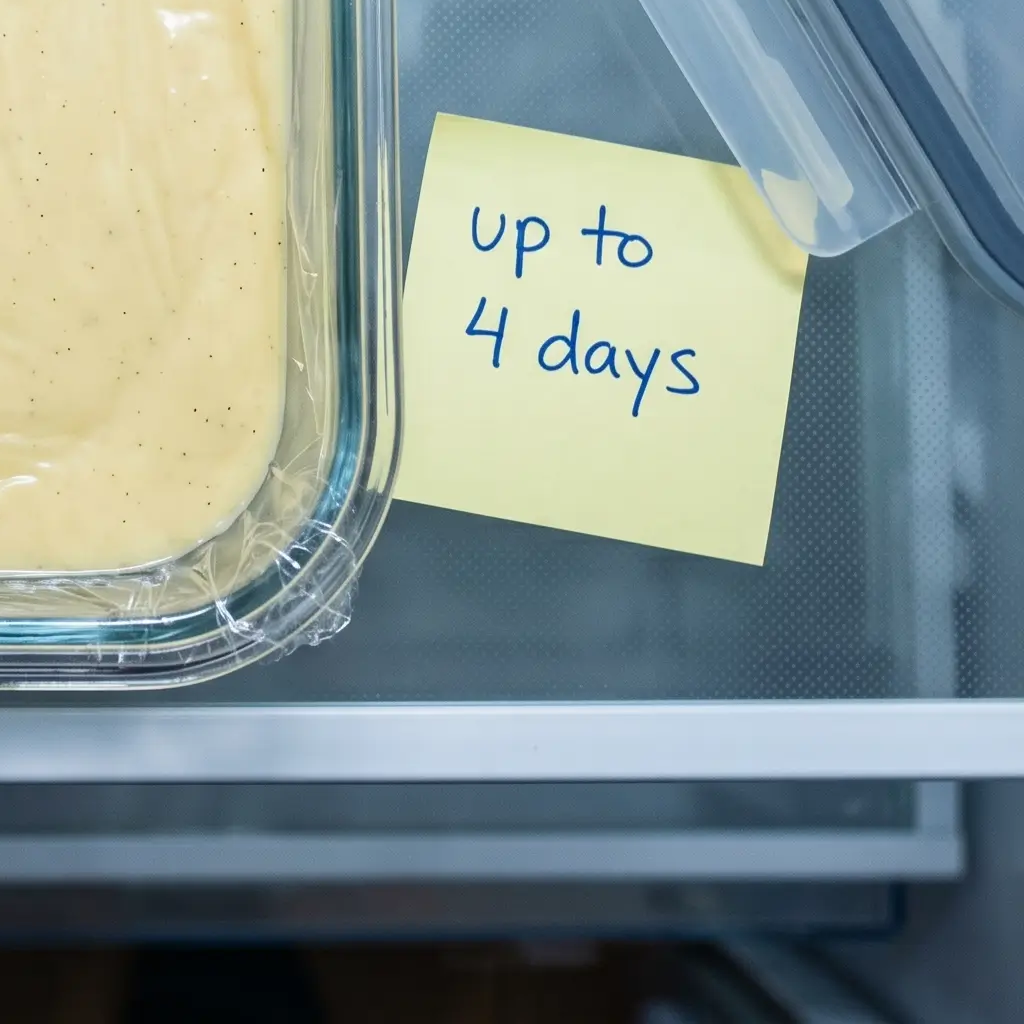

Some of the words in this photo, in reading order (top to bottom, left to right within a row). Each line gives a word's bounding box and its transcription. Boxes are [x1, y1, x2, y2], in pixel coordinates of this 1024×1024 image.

[472, 208, 550, 277] up
[581, 206, 653, 268] to
[466, 297, 508, 368] 4
[538, 311, 700, 416] days
